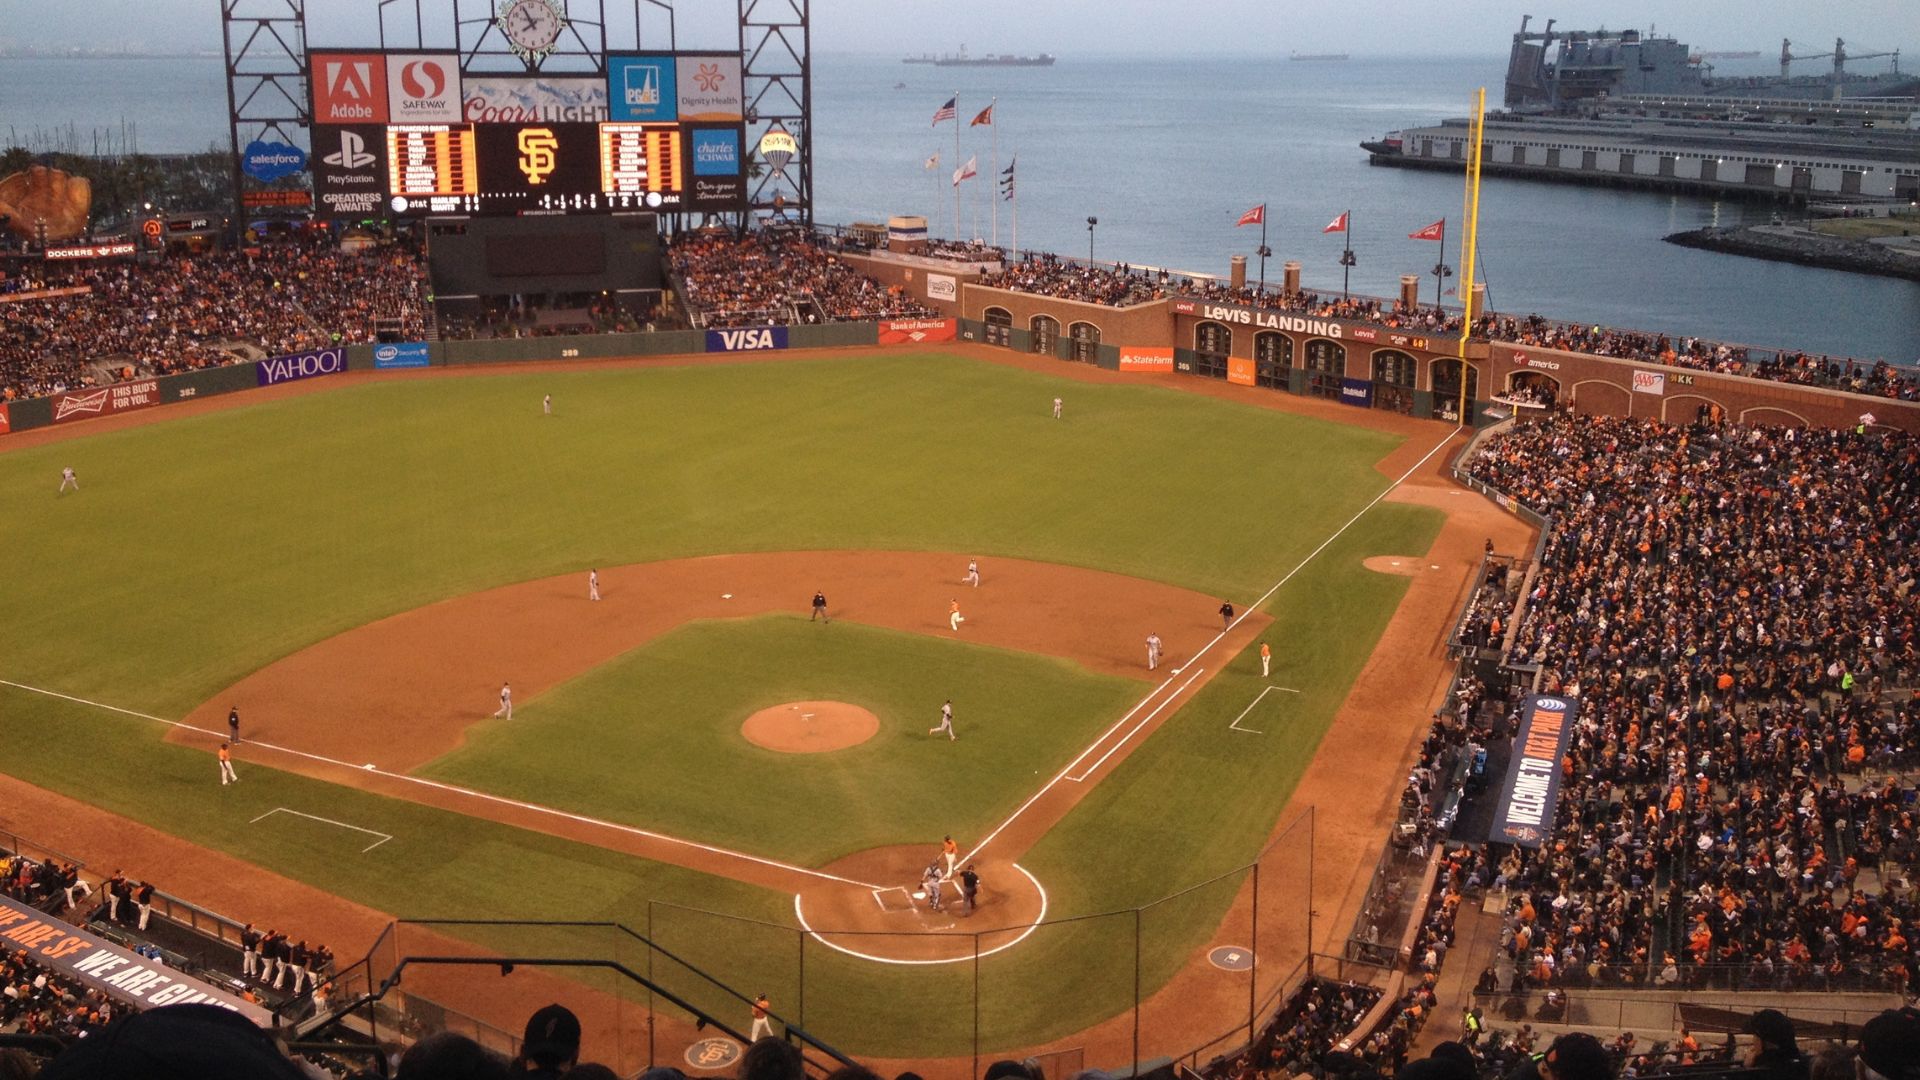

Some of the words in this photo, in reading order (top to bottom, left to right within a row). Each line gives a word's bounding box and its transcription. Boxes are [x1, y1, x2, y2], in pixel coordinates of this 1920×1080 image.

[403, 100, 446, 109] SAFEWAY
[682, 96, 710, 105] Dignity
[712, 96, 738, 104] Health
[330, 103, 373, 118] Adobe
[463, 97, 540, 122] Coors
[543, 105, 608, 122] LIGHT
[697, 142, 733, 153] charles
[250, 154, 300, 166] salesforce
[518, 128, 558, 184] SF
[697, 153, 735, 162] SCHWAB
[327, 175, 374, 186] PlayStation
[323, 193, 382, 203] GREATNESS
[621, 196, 629, 207] 2
[334, 202, 373, 212] AWAITS
[48, 249, 93, 258] DOCKERS
[112, 244, 134, 254] DECK
[890, 322, 908, 330] Bank
[908, 321, 916, 329] of
[917, 320, 945, 329] America
[1256, 312, 1343, 339] LANDING
[717, 329, 774, 350] VISA
[963, 331, 973, 339] 421
[261, 349, 342, 384] YAHOO!
[1528, 359, 1560, 370] america
[112, 386, 131, 398] THIS
[132, 382, 157, 397] BUD'S
[56, 397, 107, 412] Budweiser
[113, 397, 130, 409] FOR
[130, 395, 149, 407] YOU.
[1442, 411, 1458, 421] 309
[1529, 709, 1565, 735] PARK
[1523, 732, 1559, 760] AT&T
[1520, 757, 1554, 773] TO
[1506, 771, 1550, 825] WELCOME
[0, 920, 66, 949] ARE
[41, 936, 93, 959] SF
[73, 949, 130, 978] WE
[103, 966, 172, 997] ARE
